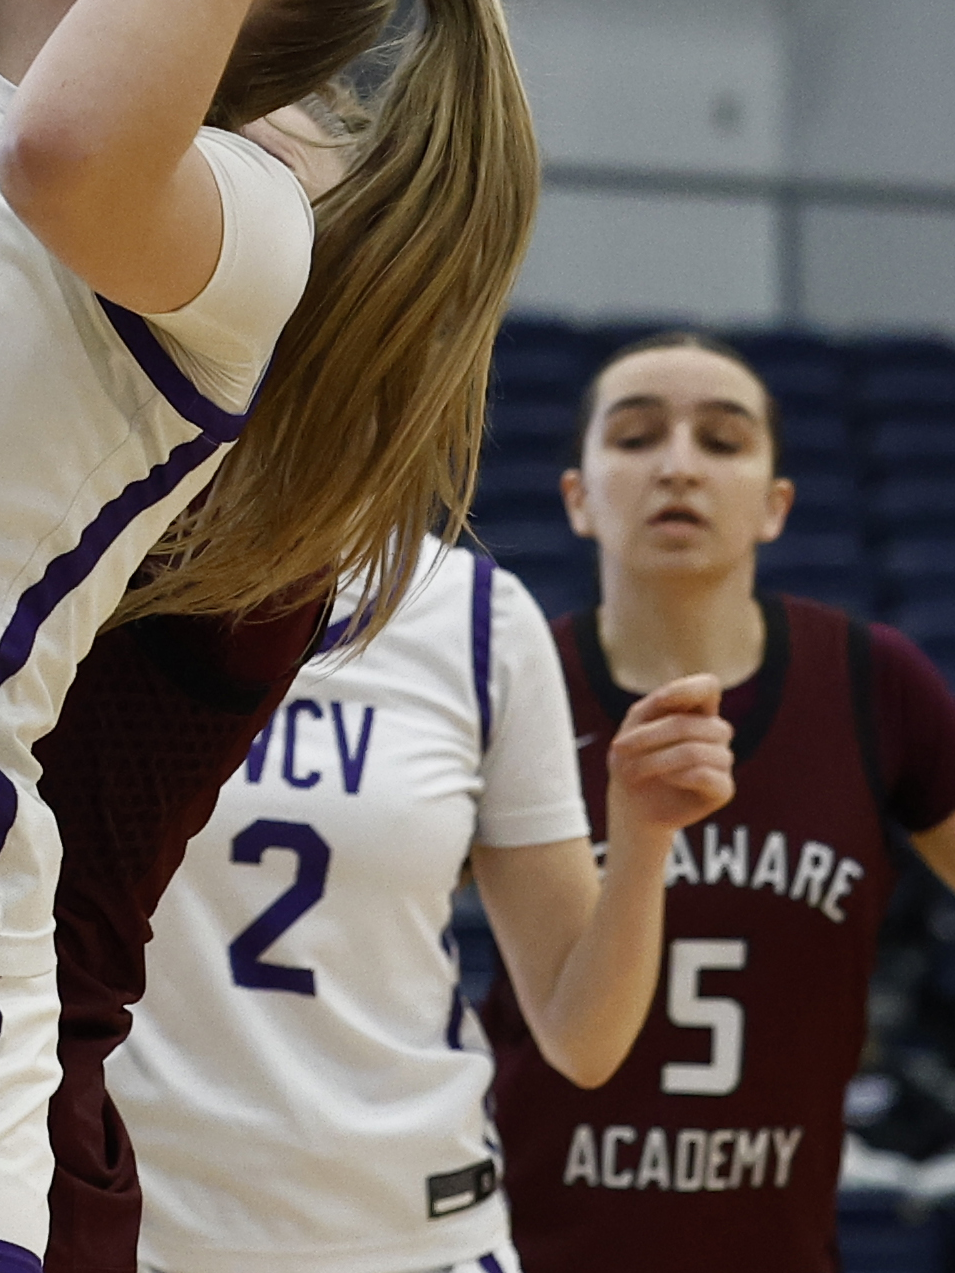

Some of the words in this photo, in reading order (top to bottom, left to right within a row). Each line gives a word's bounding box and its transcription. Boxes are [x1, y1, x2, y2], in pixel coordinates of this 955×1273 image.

[229, 819, 332, 996] 2
[593, 824, 864, 923] AWARE
[661, 939, 748, 1096] 5
[562, 1123, 804, 1192] ACADEMY
